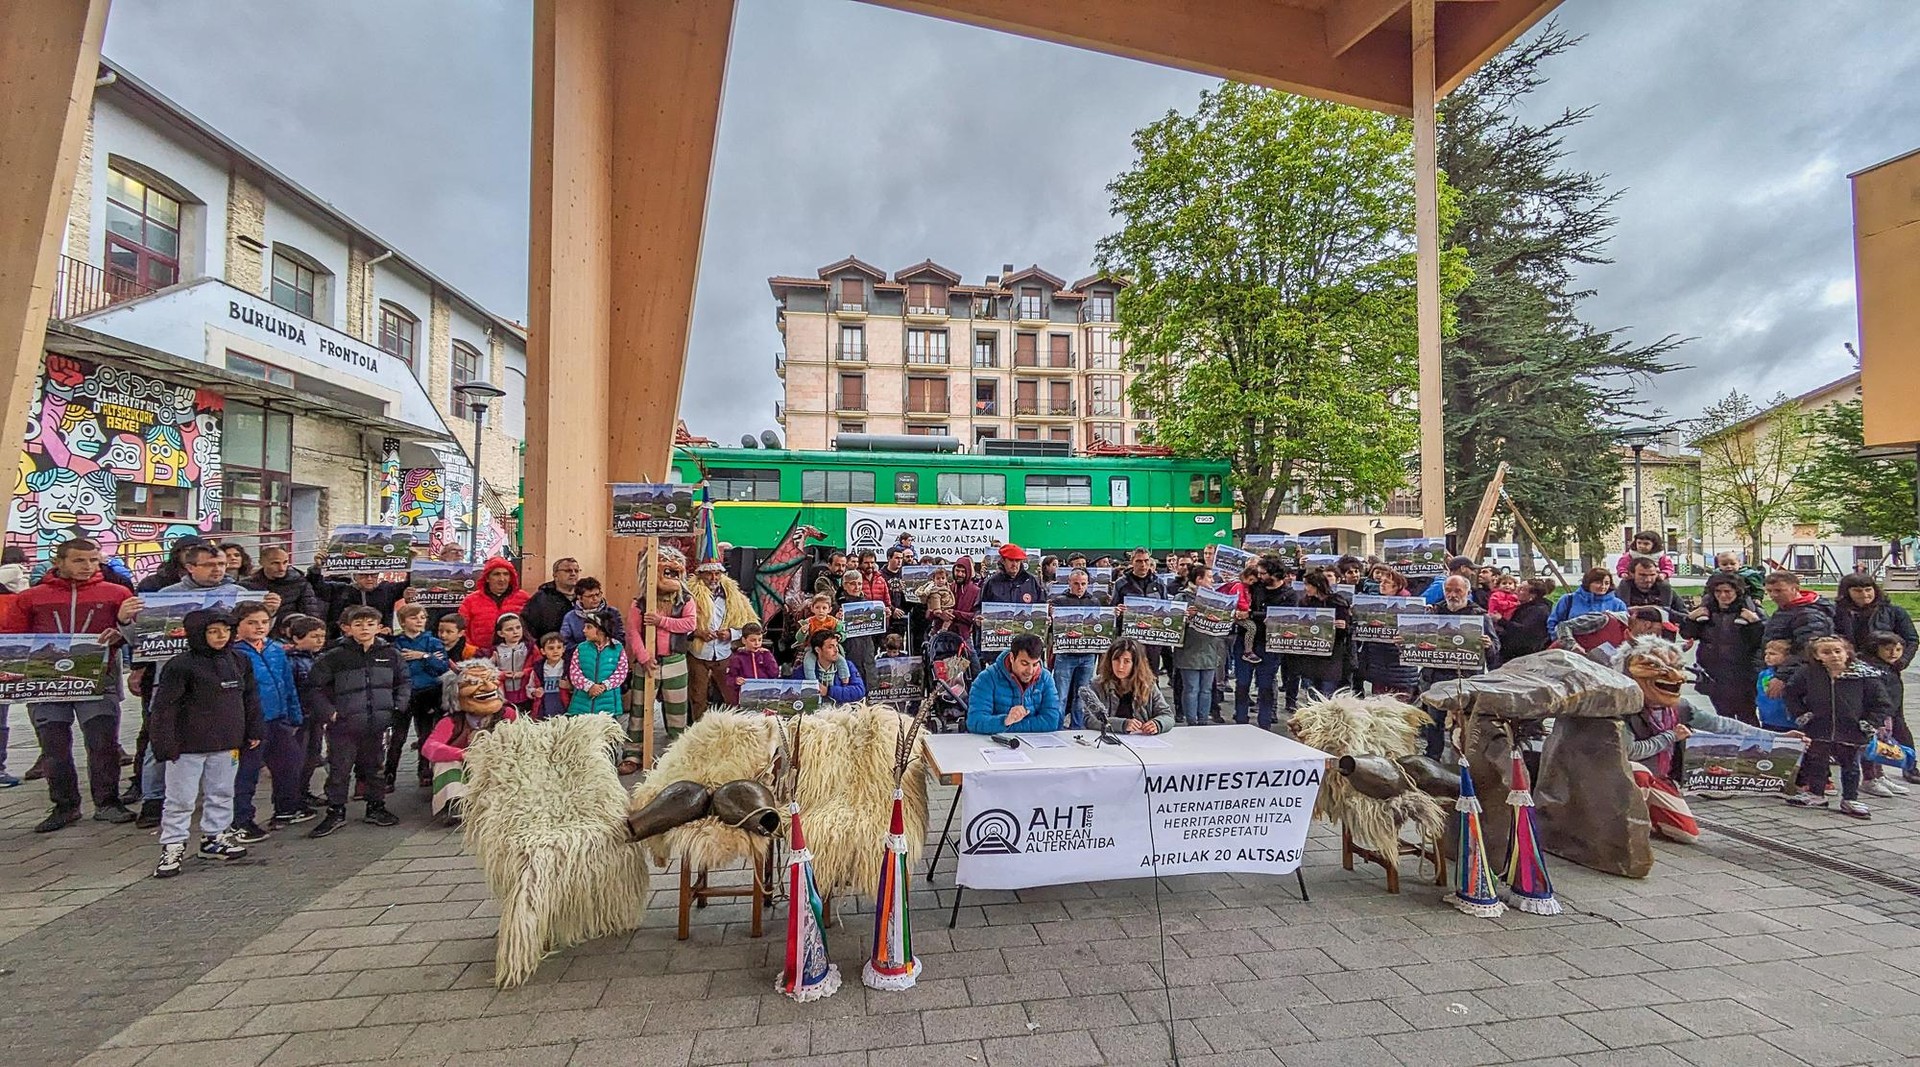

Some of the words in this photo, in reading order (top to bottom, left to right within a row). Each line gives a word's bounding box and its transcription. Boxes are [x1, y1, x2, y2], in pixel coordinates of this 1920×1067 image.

[228, 301, 307, 346] BURUNDA
[319, 337, 379, 373] FRONTOIA
[106, 416, 140, 432] ASKE!
[617, 520, 689, 528] MANIFESTAZIOA
[885, 518, 1004, 531] MANIFESTAZIOA
[894, 535, 938, 543] ARILAK
[939, 535, 952, 543] 20
[954, 534, 995, 544] ALTSASU
[919, 546, 953, 555] BADAGO
[954, 546, 985, 556] ALTERN
[326, 557, 408, 567] MANIFESTAZIOA
[1125, 627, 1180, 639] MANIFESTAZIOA
[1355, 626, 1400, 635] MANIFESTA
[142, 638, 189, 650] MANIF
[1056, 638, 1112, 646] MANIFESTAZIOA
[1269, 637, 1331, 648] MANIFESTAZIOA
[1403, 649, 1480, 661] MANIFESTAZIOA
[0, 680, 96, 692] IFESTAZIOA
[1144, 768, 1320, 794] MANIFESTAZIOA
[1689, 775, 1785, 787] MANIFESTAZIOA
[1156, 798, 1266, 814] ALTERNATIBAREN
[1269, 797, 1303, 808] ALDE
[1028, 805, 1094, 831] AHT
[1085, 808, 1094, 828] aren
[1164, 814, 1250, 829] HERRITARRON
[1255, 813, 1292, 824] HITZA
[1026, 828, 1092, 843] AURREAN
[1183, 826, 1268, 840] ERRESPETATU
[1025, 837, 1116, 853] ALTERNATIBA
[1140, 850, 1210, 868] APIRILAK
[1214, 849, 1232, 861] 20
[1236, 848, 1303, 863] ALTSASU
